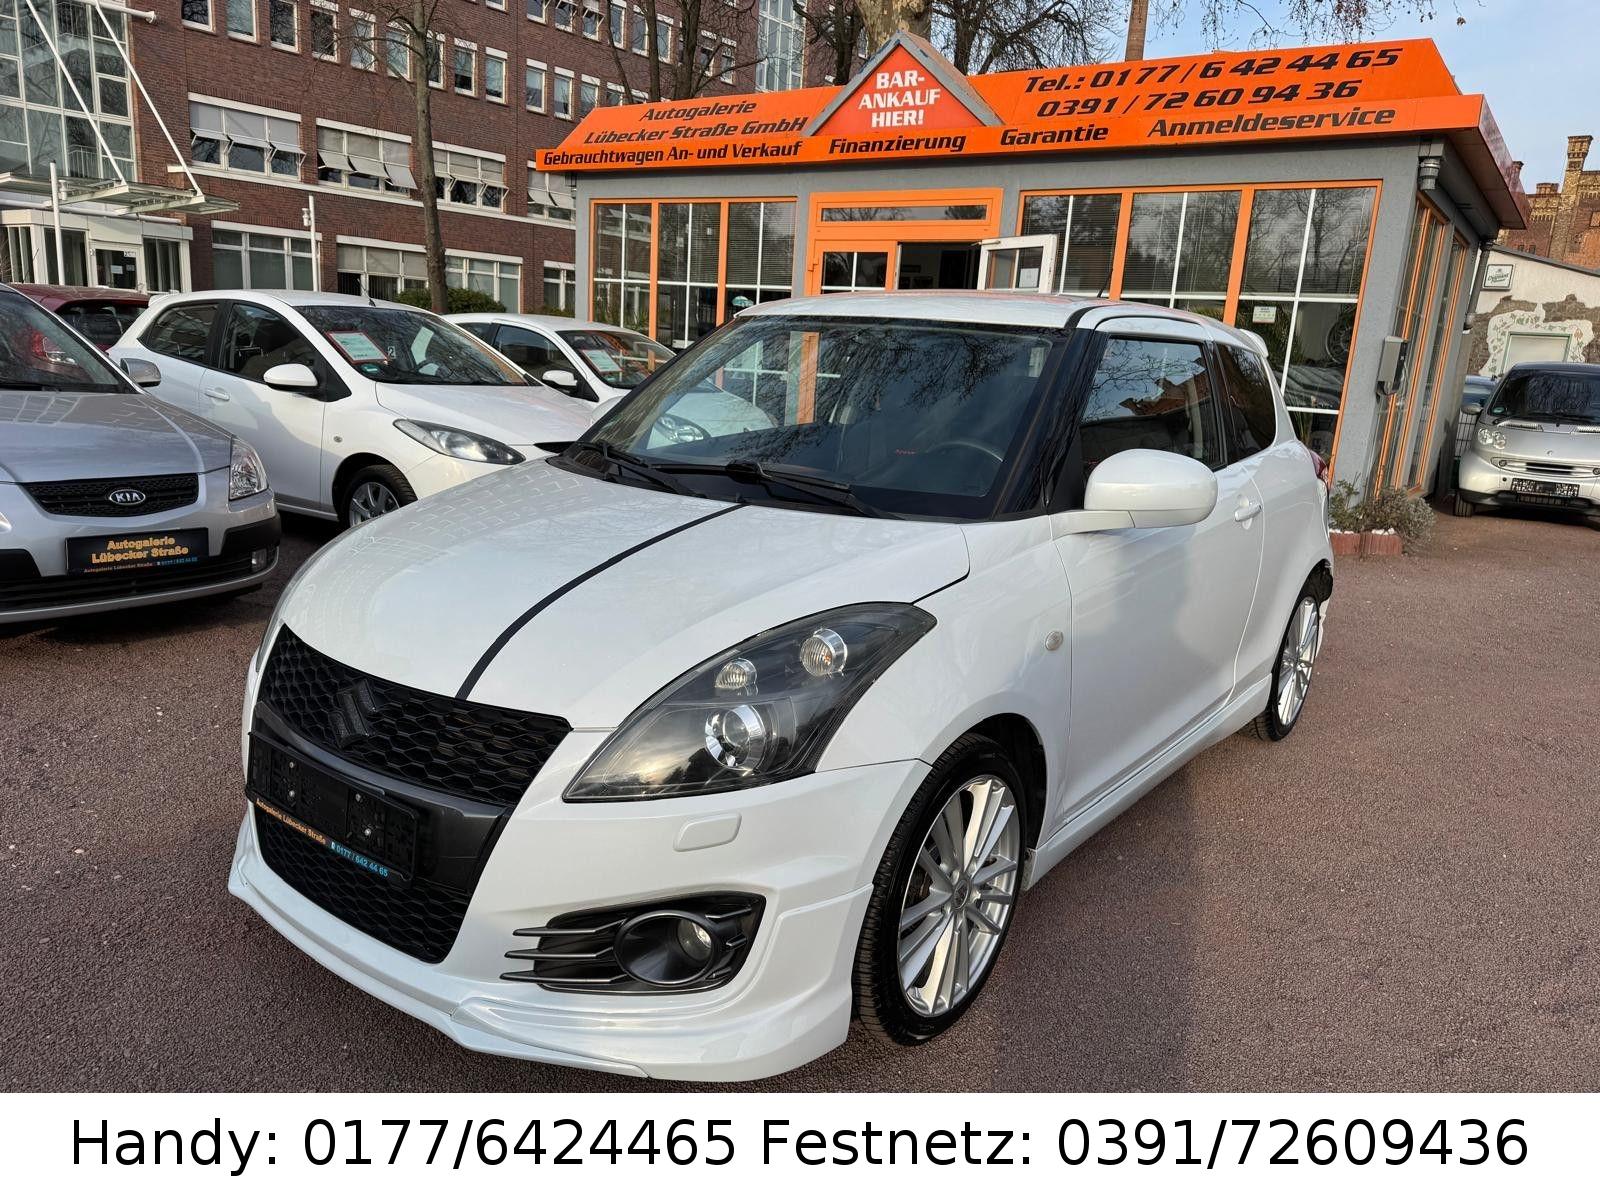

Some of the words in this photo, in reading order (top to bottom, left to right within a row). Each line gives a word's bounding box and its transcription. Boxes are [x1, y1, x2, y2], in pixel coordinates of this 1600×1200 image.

[876, 69, 926, 89] BAR-
[1024, 74, 1086, 93] Tel.:
[1090, 64, 1181, 90] 0177
[1199, 61, 1226, 79] 6
[1229, 57, 1282, 76] 42
[1286, 53, 1341, 72] 44
[1346, 48, 1404, 68] 65
[858, 89, 941, 109] ANKAUF
[1037, 97, 1119, 117] 0391
[1143, 91, 1189, 111] 72
[1193, 88, 1245, 108] 60
[1248, 84, 1301, 104] 94
[1306, 80, 1363, 100] 36
[639, 100, 757, 121] Autogalerie
[871, 109, 925, 128] HIER!
[584, 128, 670, 144] Lübecker
[669, 122, 739, 139] Straße
[741, 116, 809, 135] GmbH
[1147, 107, 1396, 138] Anmeldeservice
[829, 135, 967, 154] Finanzierung
[1000, 124, 1109, 146] Garantie
[543, 149, 664, 166] Gebrauchtwagen
[666, 146, 694, 161] An-
[697, 144, 729, 159] und
[732, 141, 803, 158] Verkauf
[115, 492, 142, 503] KIA
[107, 536, 176, 551] Autogalerie
[91, 550, 149, 564] Lübecker
[151, 545, 190, 558] Straße
